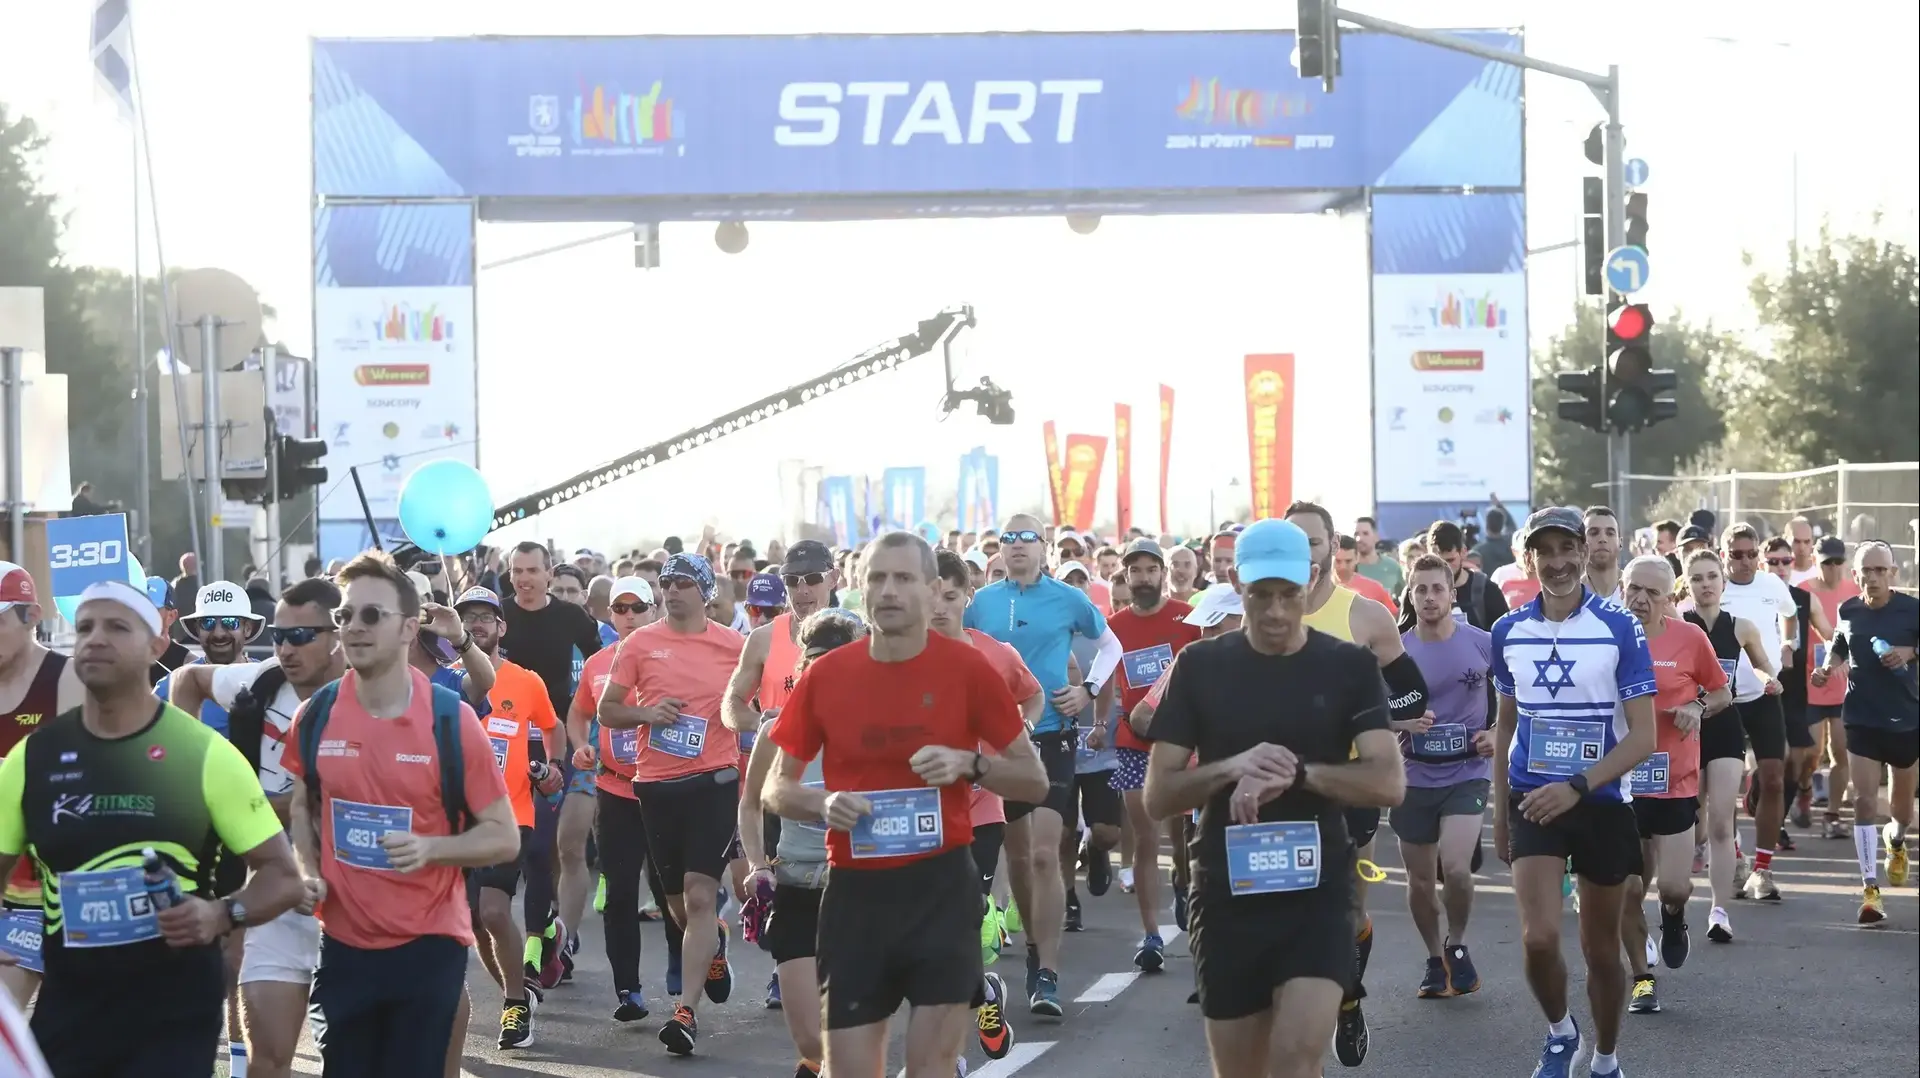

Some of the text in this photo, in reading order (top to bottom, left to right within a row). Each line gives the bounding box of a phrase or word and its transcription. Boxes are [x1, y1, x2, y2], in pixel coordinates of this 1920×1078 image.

[774, 79, 1103, 146] START
[50, 540, 121, 569] 3:30
[204, 589, 233, 604] ciele
[1599, 598, 1646, 648] ISRAEL
[572, 660, 584, 670] TH
[1137, 662, 1158, 675] 4782
[1653, 660, 1677, 668] saucony
[661, 727, 683, 744] 4321
[623, 740, 638, 752] 447
[1424, 740, 1447, 751] 4521
[1545, 741, 1577, 758] 9597
[396, 753, 432, 765] saucony
[1630, 770, 1648, 782] 622
[94, 795, 155, 812] FITNESS
[871, 815, 909, 835] 4808
[346, 827, 378, 849] 4831
[1248, 849, 1289, 871] 9535
[80, 900, 121, 923] 4781
[6, 927, 43, 950] 4469
